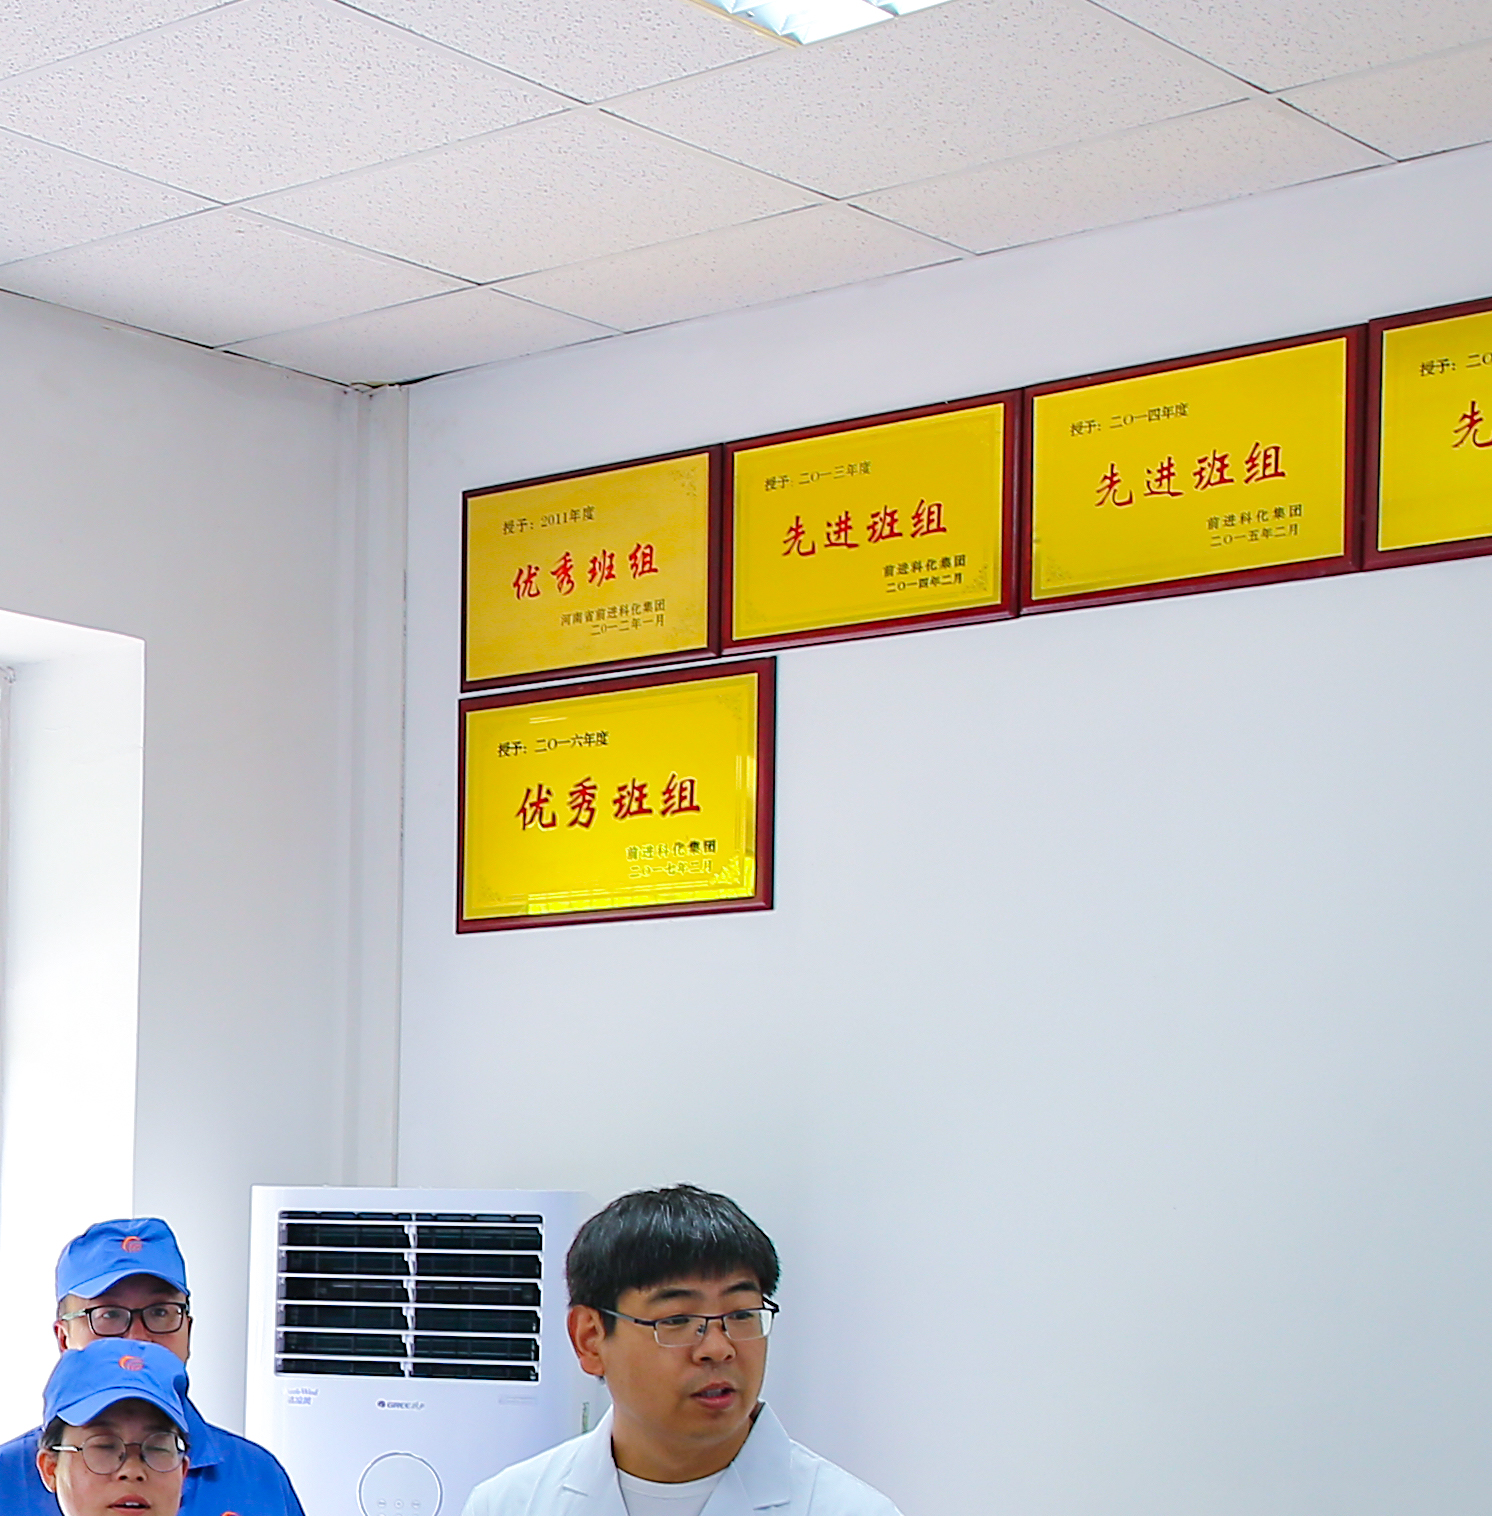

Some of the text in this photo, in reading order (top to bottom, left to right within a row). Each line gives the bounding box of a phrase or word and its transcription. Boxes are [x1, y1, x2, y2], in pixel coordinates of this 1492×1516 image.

[1452, 400, 1492, 448] 先
[1094, 441, 1286, 507] 先进班组
[782, 498, 947, 557] 先进班组
[1207, 503, 1303, 530] 前进科化集团
[512, 543, 659, 600] 优秀班组
[883, 554, 966, 577] 前进科化集团
[561, 598, 666, 627] 河南省前进科化集团
[516, 773, 701, 831] 优秀班组
